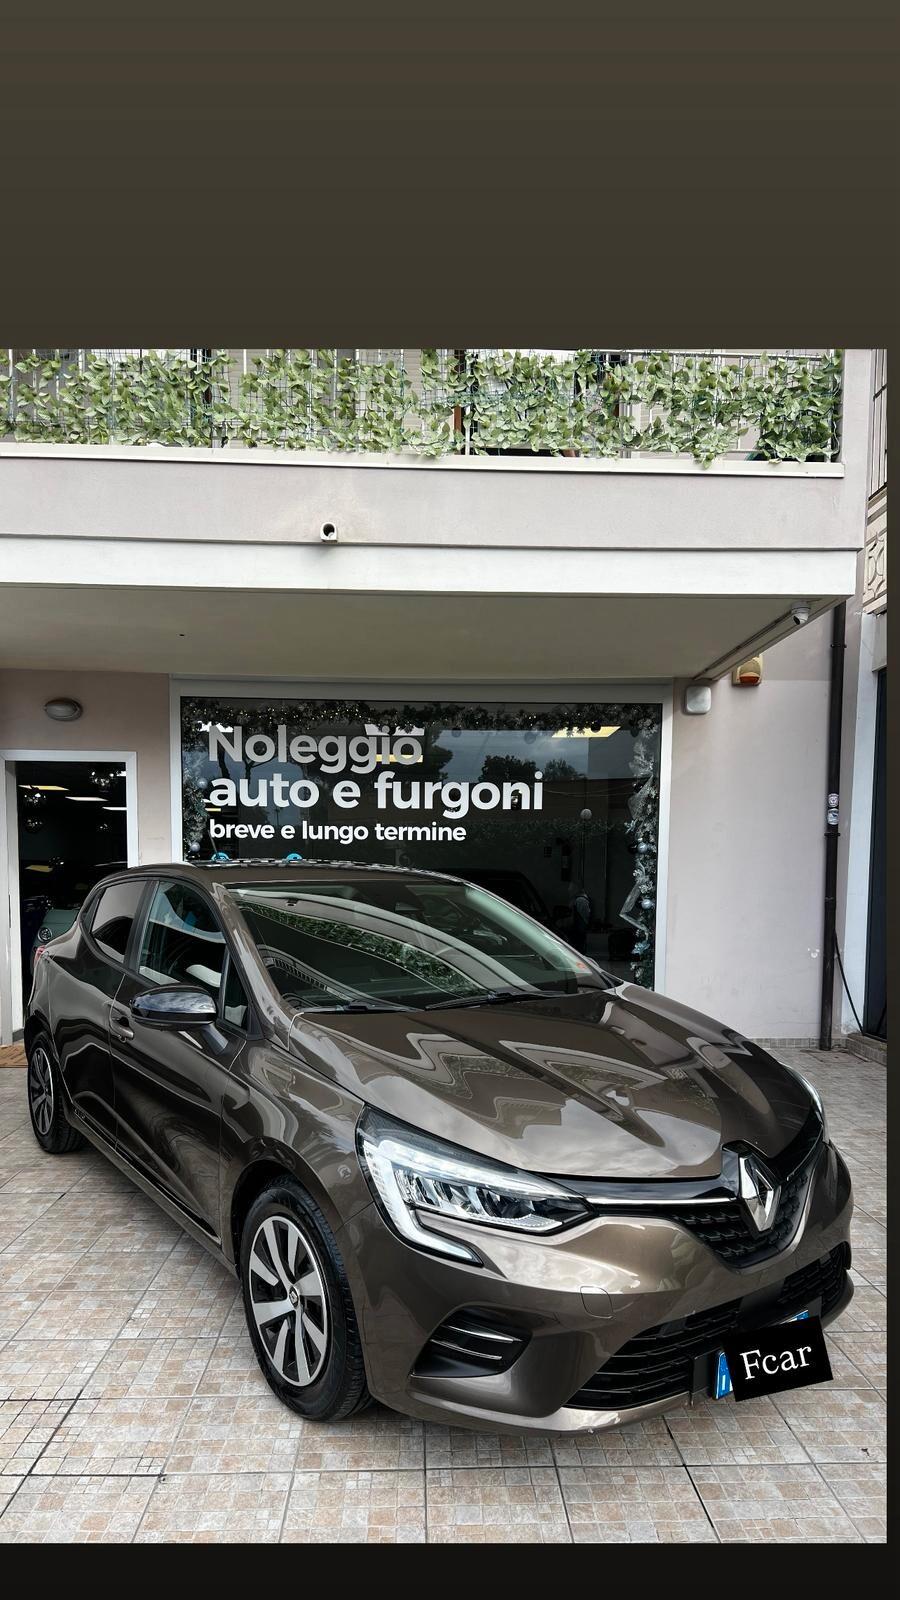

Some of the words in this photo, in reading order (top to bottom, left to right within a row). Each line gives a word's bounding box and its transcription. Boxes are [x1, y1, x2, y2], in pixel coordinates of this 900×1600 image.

[208, 724, 423, 774] Noleggio
[209, 773, 320, 809] auto
[332, 780, 361, 809] e
[374, 771, 543, 819] furgoni
[209, 818, 275, 839] breve
[280, 824, 296, 840] e
[302, 820, 369, 845] lungo
[374, 821, 467, 841] termine
